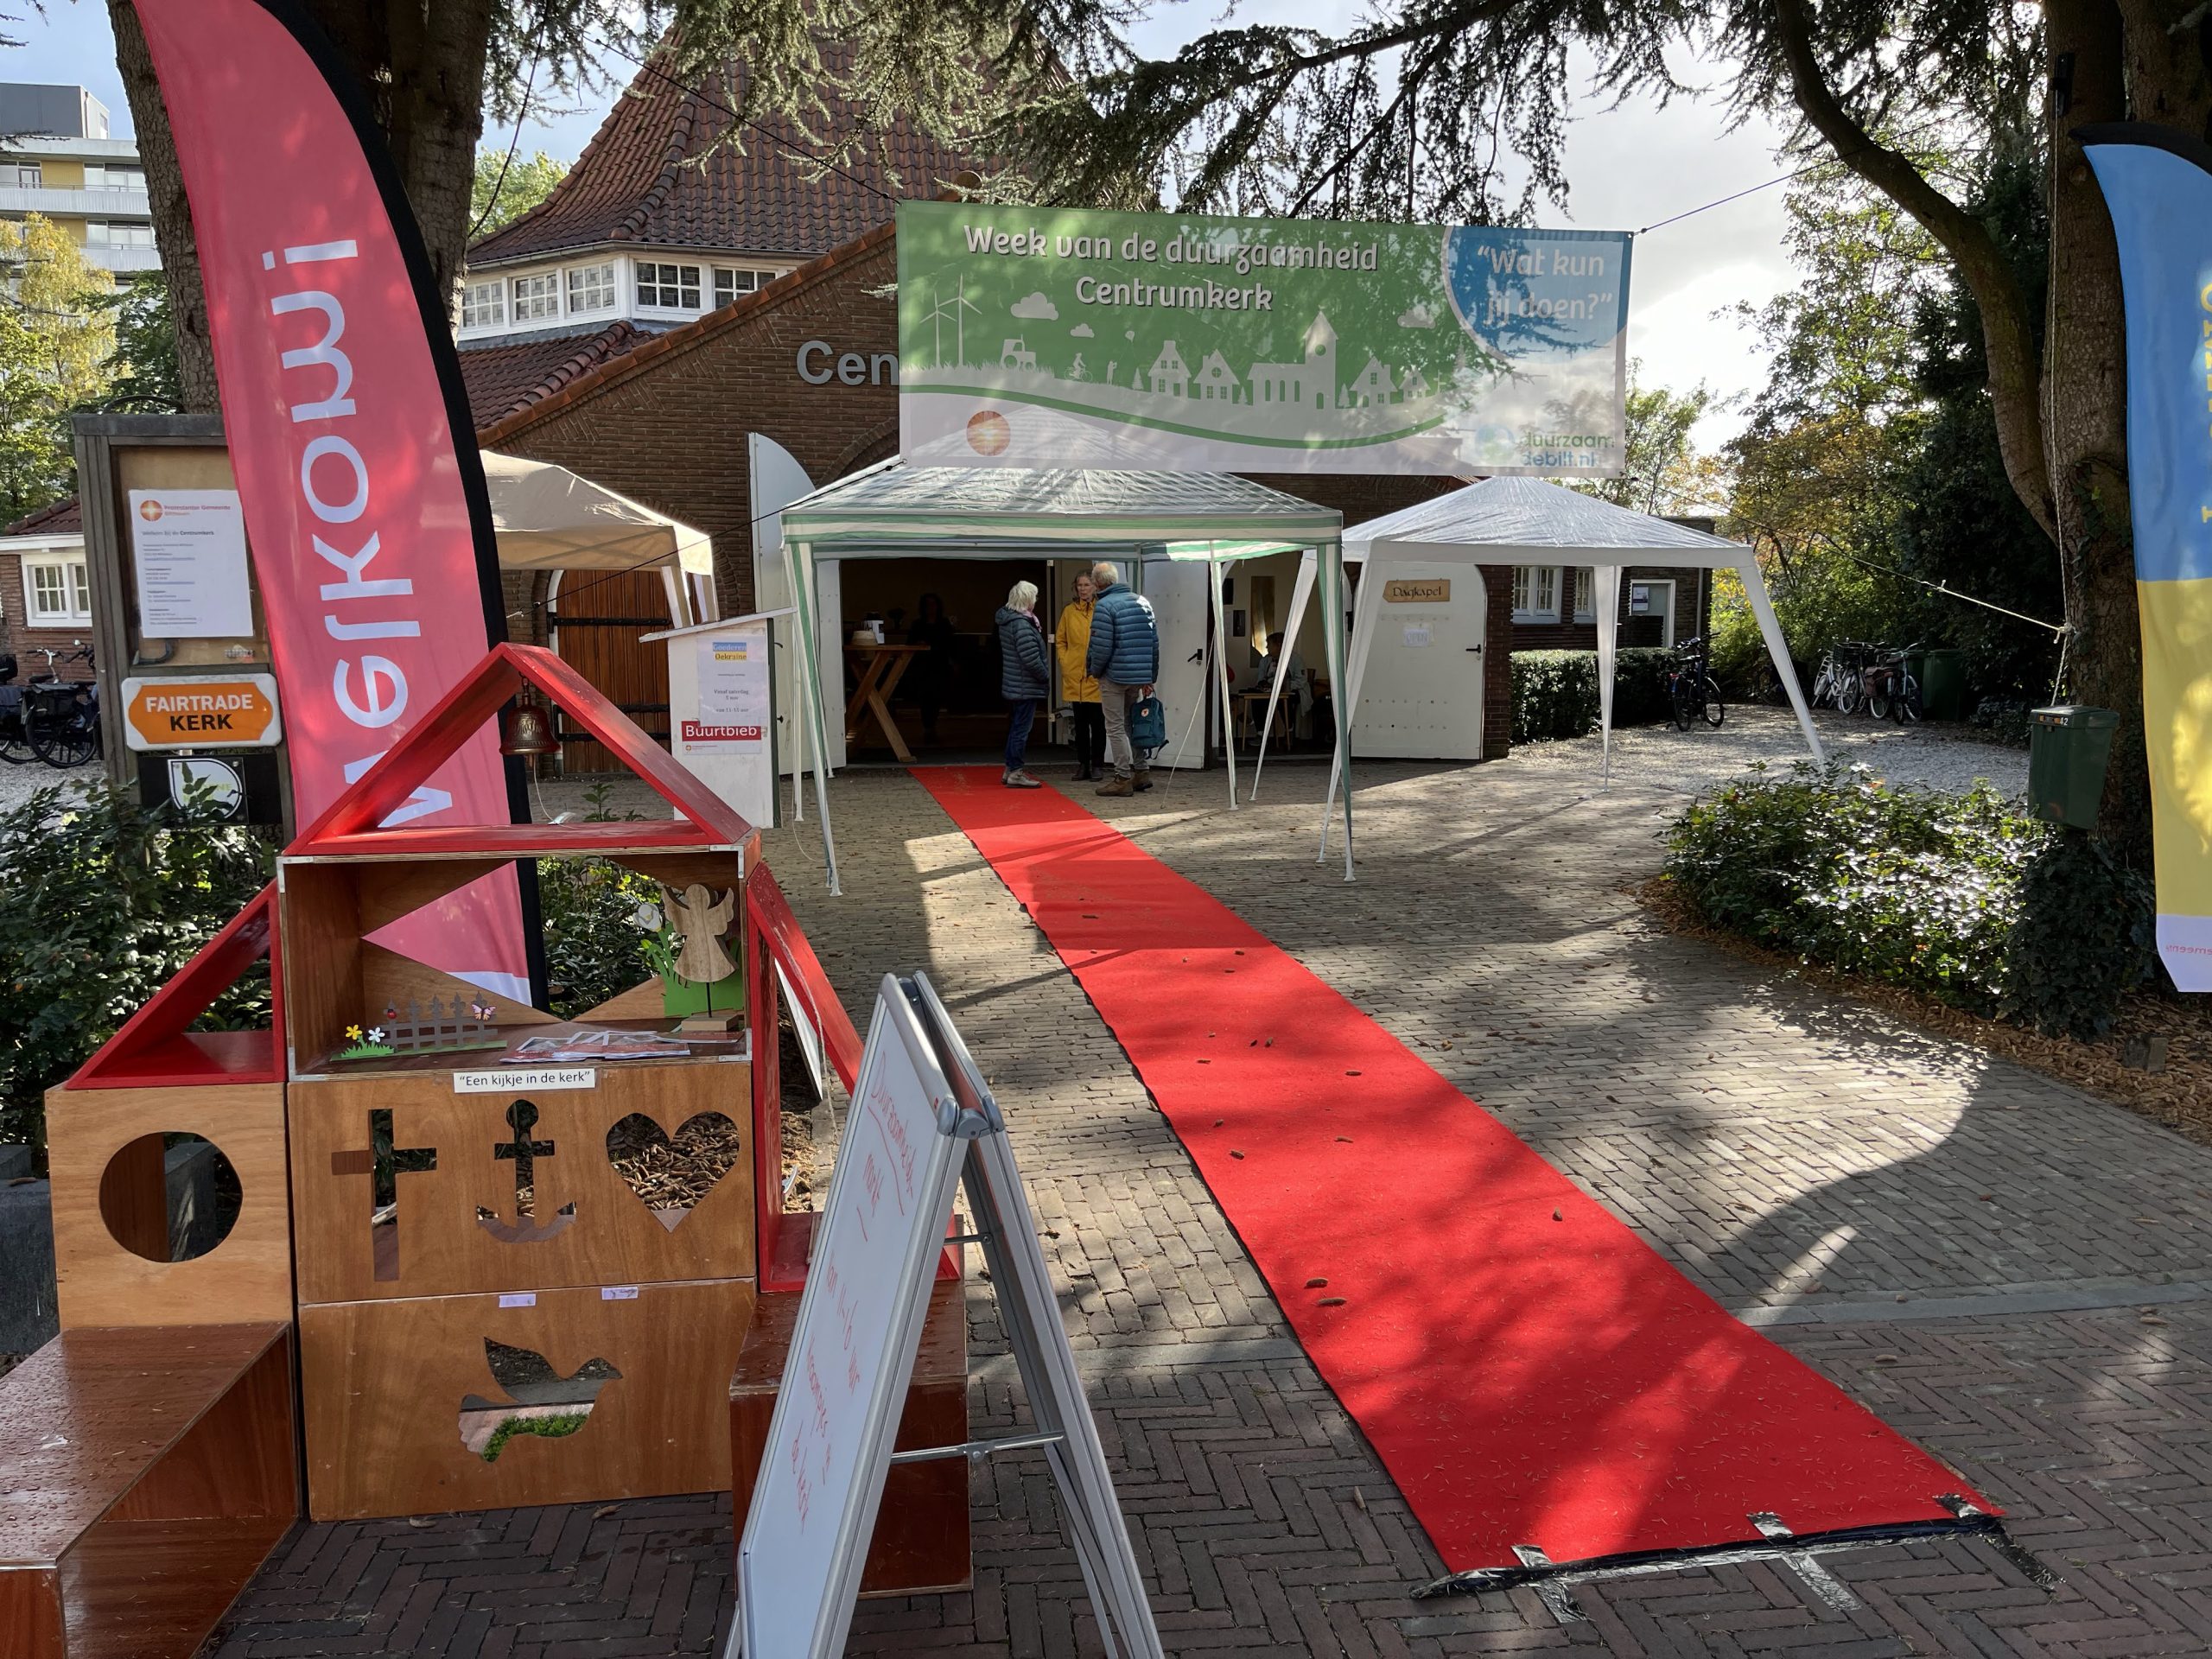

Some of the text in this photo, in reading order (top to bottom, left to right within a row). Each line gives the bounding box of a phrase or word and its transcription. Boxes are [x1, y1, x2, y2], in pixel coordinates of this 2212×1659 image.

[963, 225, 1380, 275] Week van de duurzaamheid
[1553, 249, 1605, 276] kun
[1075, 276, 1274, 313] Centrumkerk
[1483, 289, 1511, 326] jij
[1393, 586, 1441, 599] Dagkapel
[146, 694, 253, 713] FAIRTRADE
[169, 714, 233, 732] KERK
[685, 725, 758, 737] Buurtbieb
[459, 1071, 590, 1088] “Een kijkje in de kerk”
